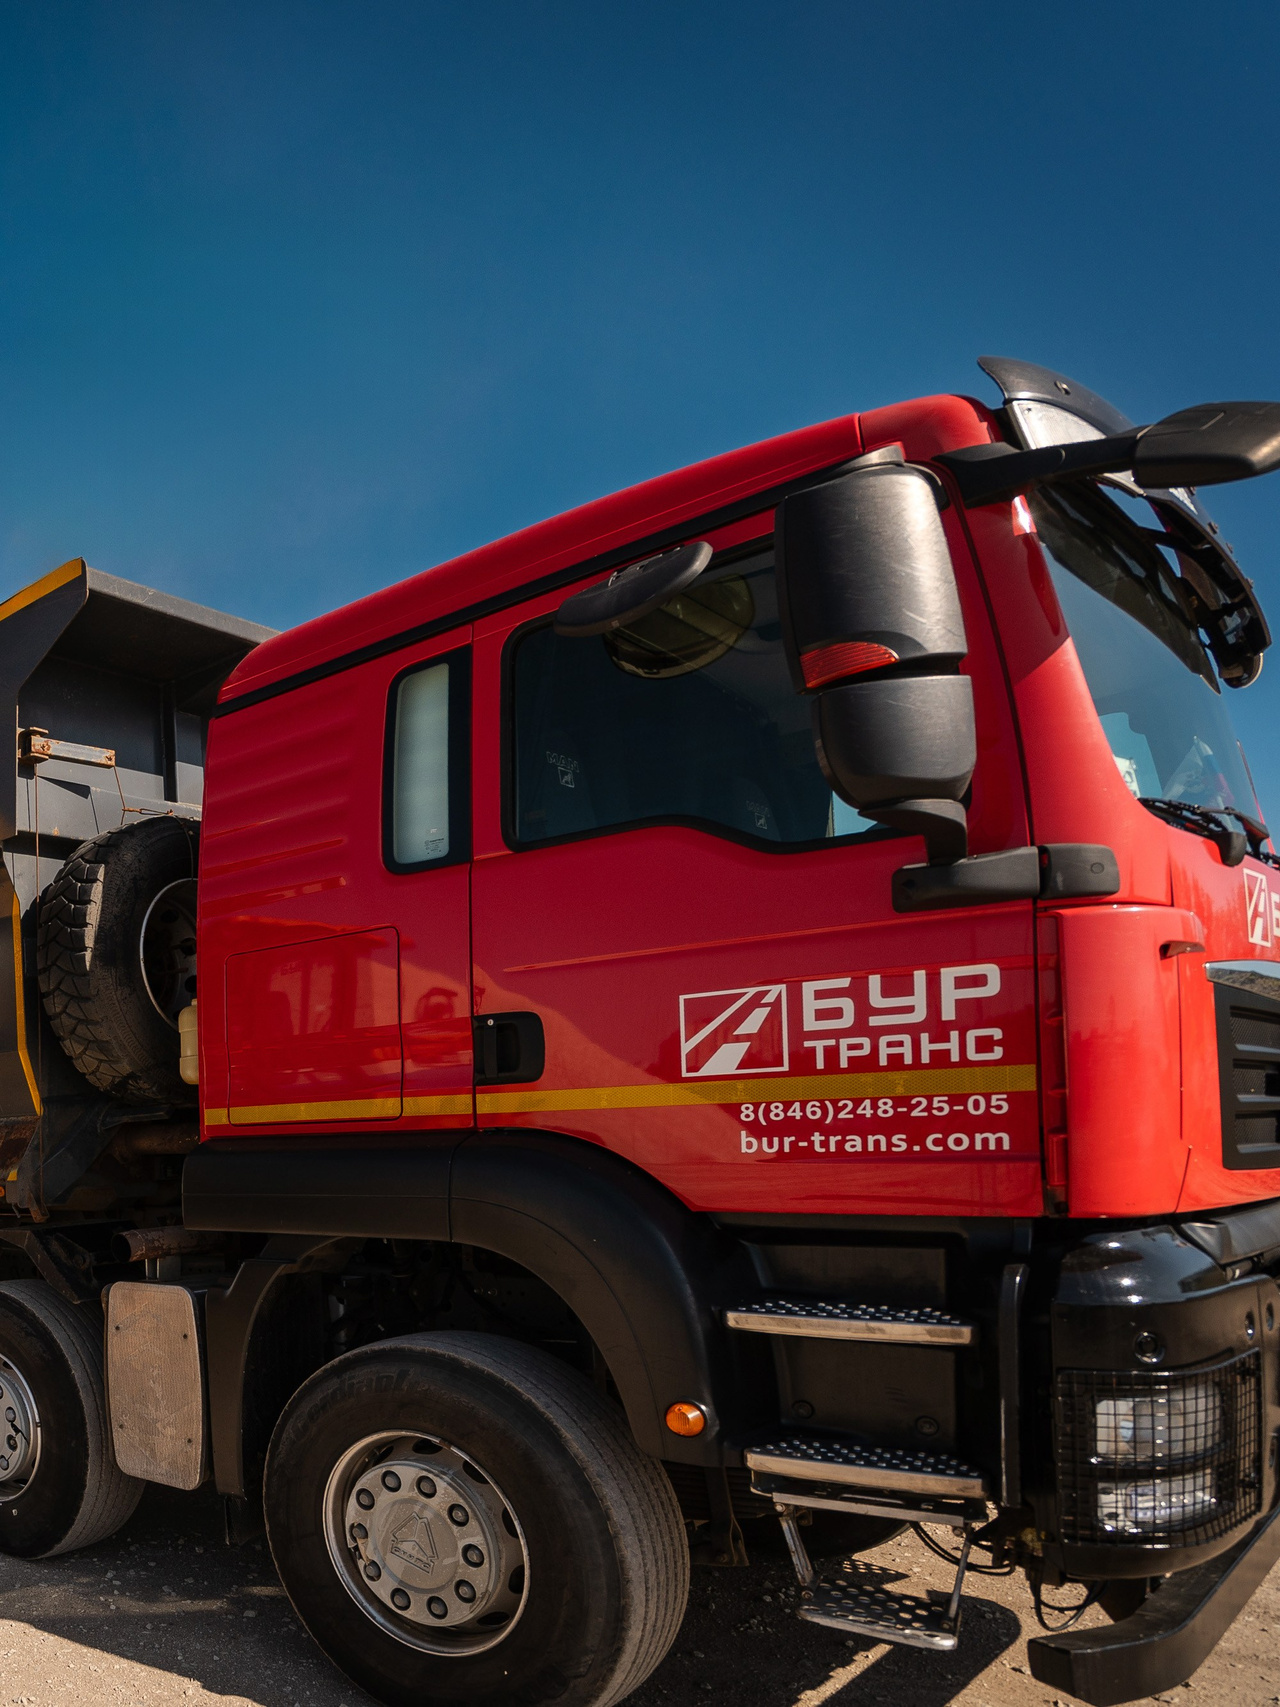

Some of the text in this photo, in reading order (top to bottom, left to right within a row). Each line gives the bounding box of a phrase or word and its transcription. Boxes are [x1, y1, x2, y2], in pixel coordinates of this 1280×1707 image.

[545, 751, 580, 773] MAN
[802, 963, 1001, 1032] БУР
[803, 1027, 1004, 1070] ТРАНС
[740, 1094, 1010, 1126] 8(846)248-25-05
[740, 1130, 1011, 1154] bur-trans.com
